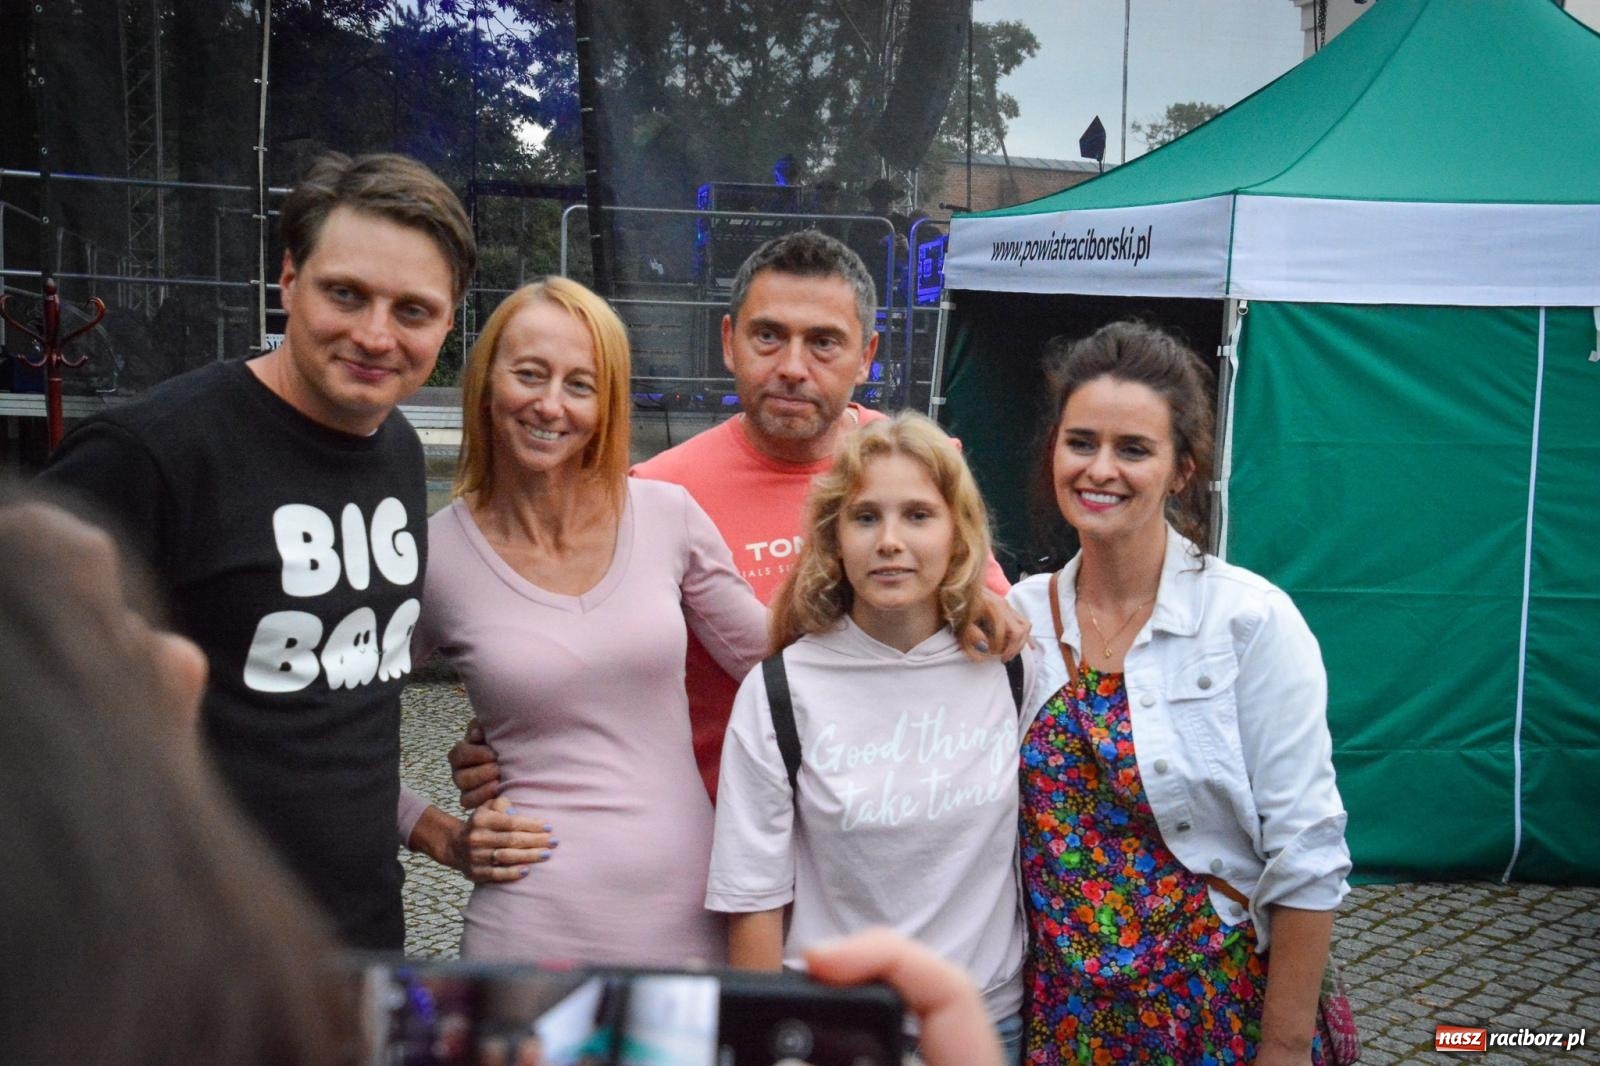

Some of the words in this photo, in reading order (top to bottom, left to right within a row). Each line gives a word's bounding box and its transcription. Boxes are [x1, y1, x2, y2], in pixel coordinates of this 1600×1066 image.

[990, 225, 1152, 266] www.powiatraciborski.pl
[272, 497, 419, 597] BIG
[811, 710, 909, 772] Good
[837, 770, 921, 831] take
[920, 767, 1001, 821] time
